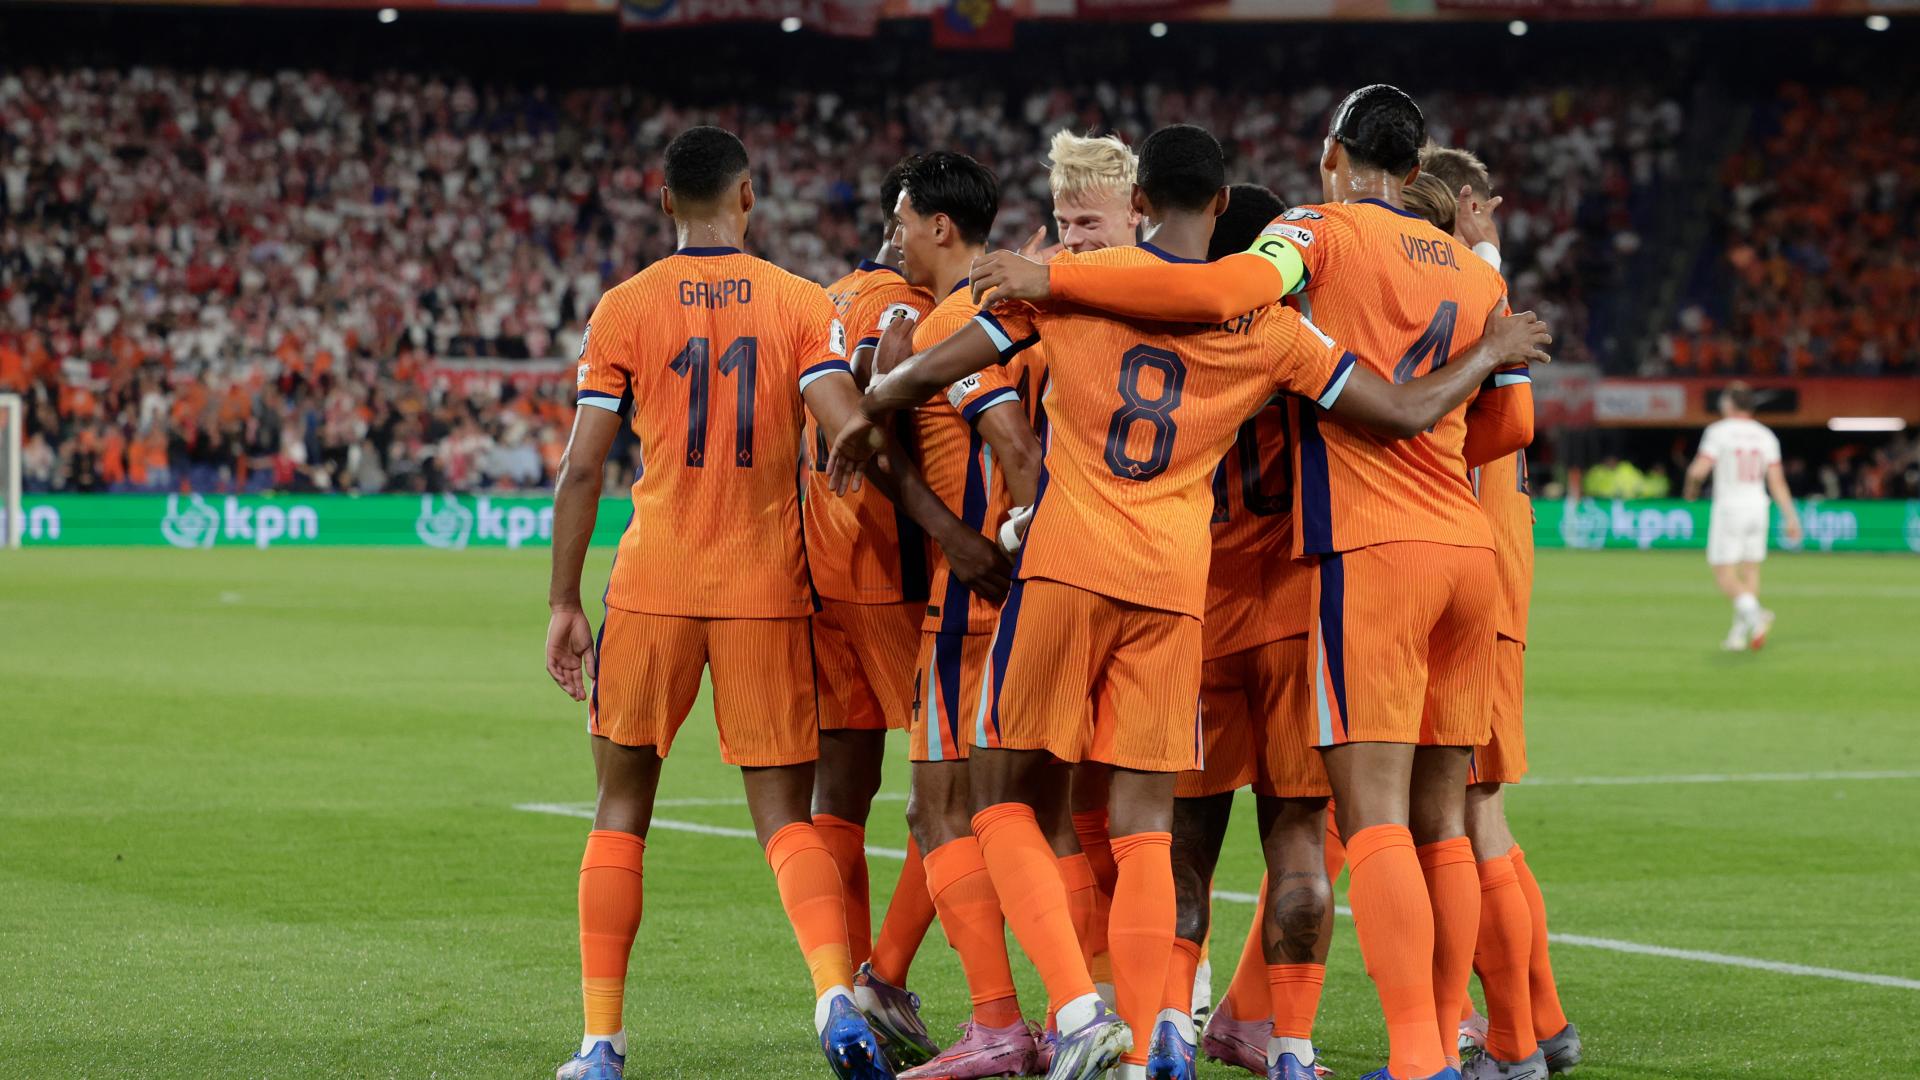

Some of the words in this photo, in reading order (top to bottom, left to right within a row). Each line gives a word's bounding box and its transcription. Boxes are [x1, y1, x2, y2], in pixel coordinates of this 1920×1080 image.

[1259, 240, 1285, 258] C
[1400, 233, 1460, 271] VIRGIL
[679, 278, 752, 309] GAKPO
[1393, 299, 1458, 385] 4
[668, 336, 757, 468] 11
[1103, 343, 1187, 482] 8
[224, 496, 318, 549] kpn
[1611, 498, 1693, 549] kpn
